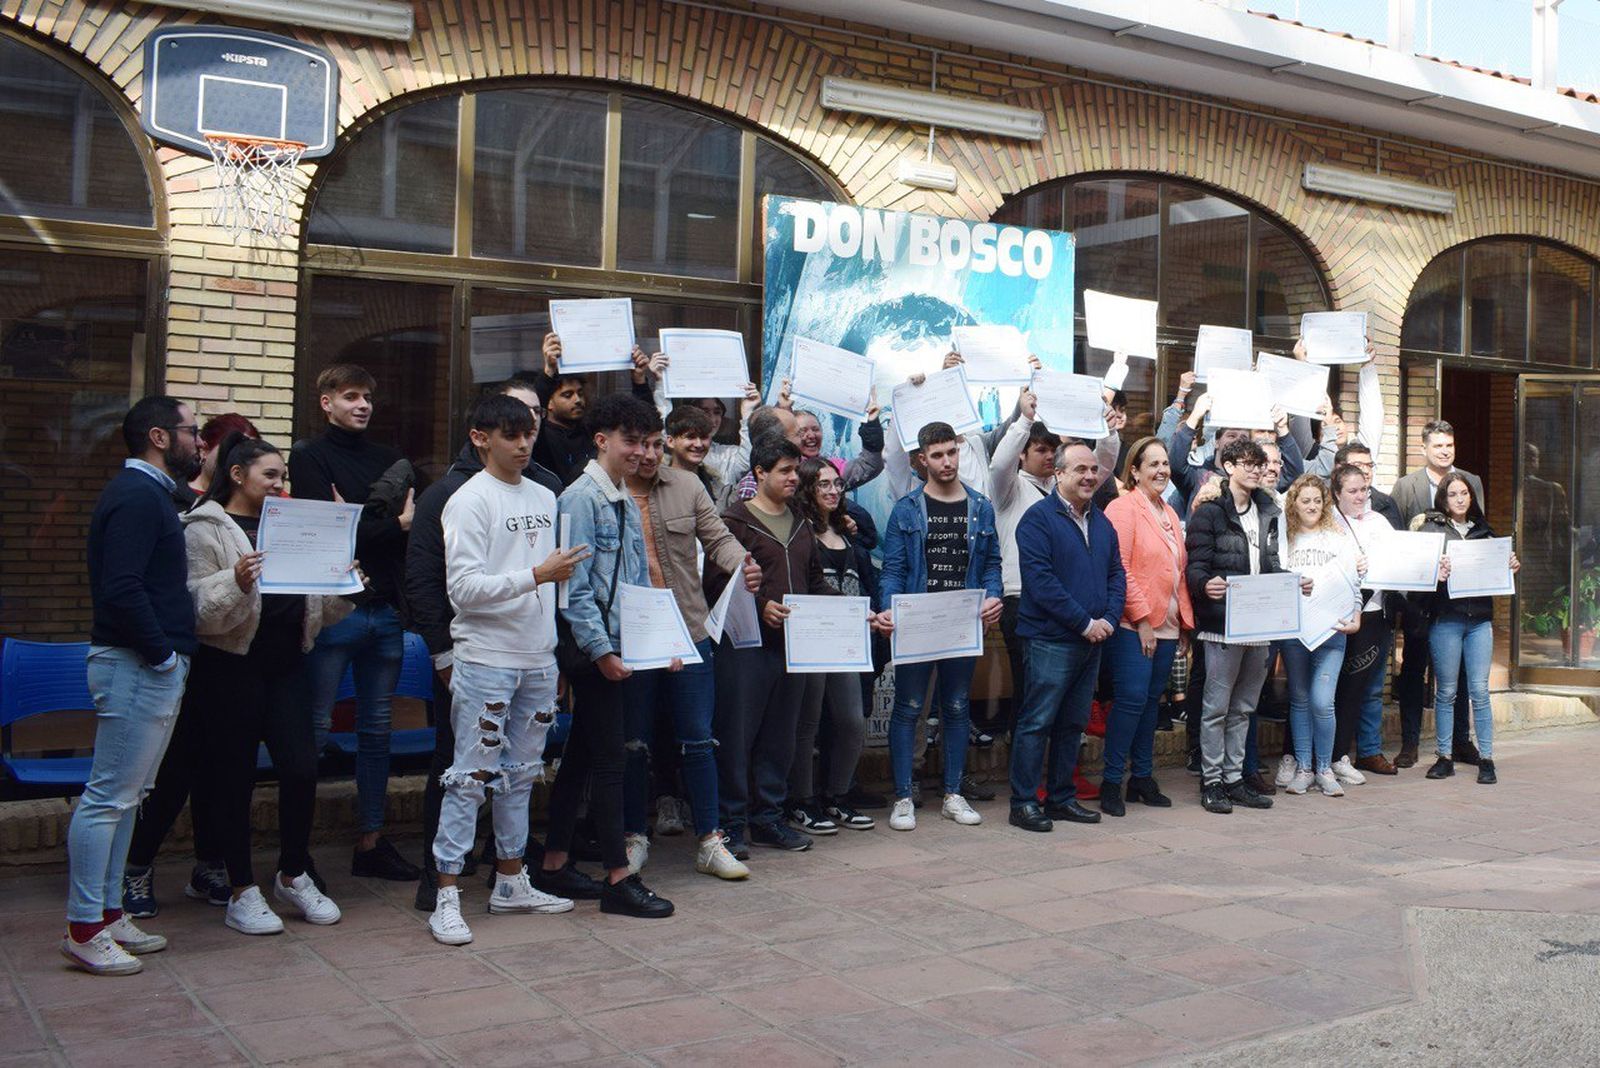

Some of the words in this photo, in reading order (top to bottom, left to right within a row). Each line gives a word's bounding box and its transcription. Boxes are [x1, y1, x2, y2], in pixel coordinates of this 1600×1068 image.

[790, 200, 896, 261] DON
[909, 215, 1053, 280] BOSCO
[505, 514, 552, 532] GUESS
